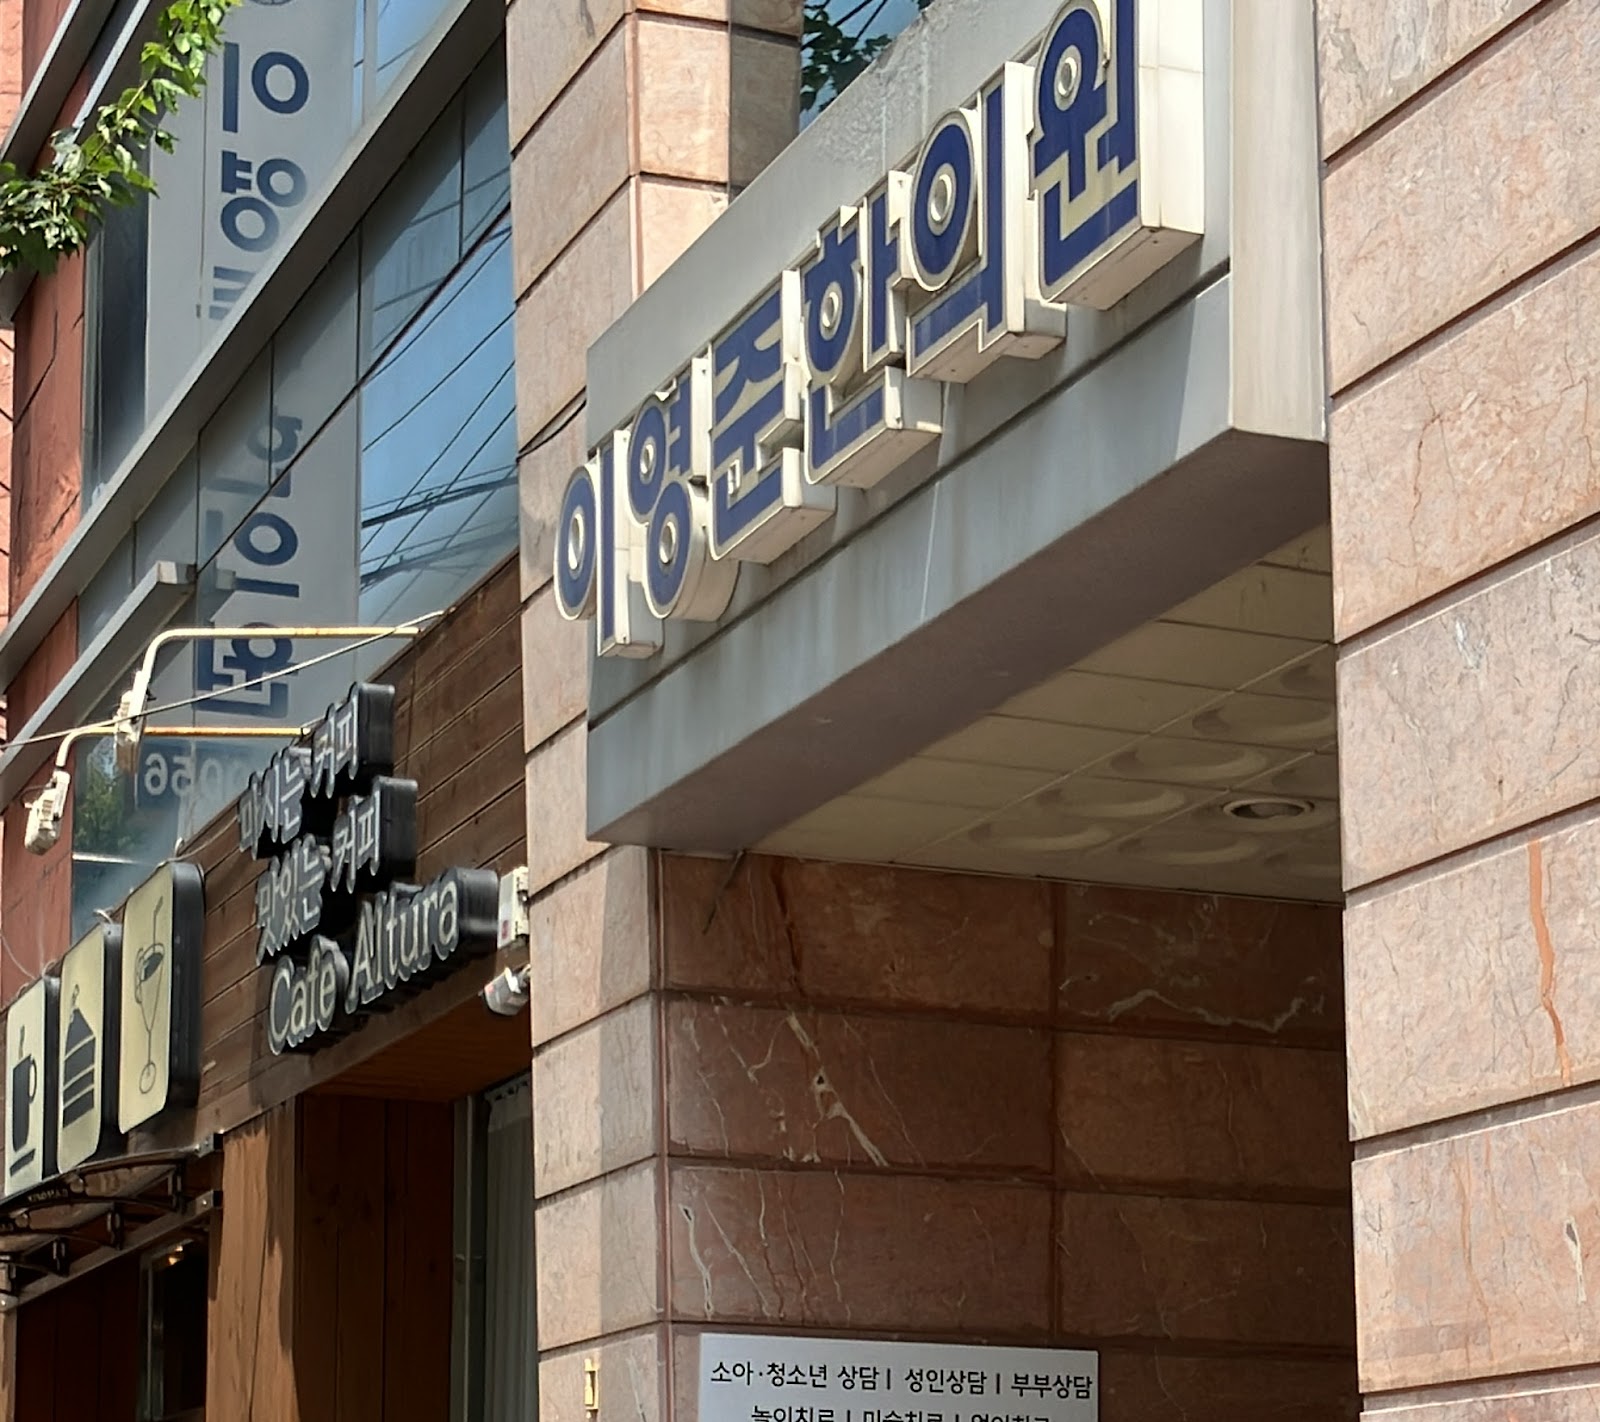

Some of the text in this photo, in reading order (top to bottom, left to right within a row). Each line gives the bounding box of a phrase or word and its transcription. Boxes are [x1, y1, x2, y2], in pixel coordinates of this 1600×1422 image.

[553, 0, 1142, 658] 이영준한의원
[311, 683, 360, 799] 커피
[331, 776, 381, 893] 커피
[268, 872, 460, 1056] Cafe Altura
[836, 1365, 881, 1391] 상담
[904, 1368, 988, 1396] 성인상담
[1010, 1373, 1094, 1400] 부부상담
